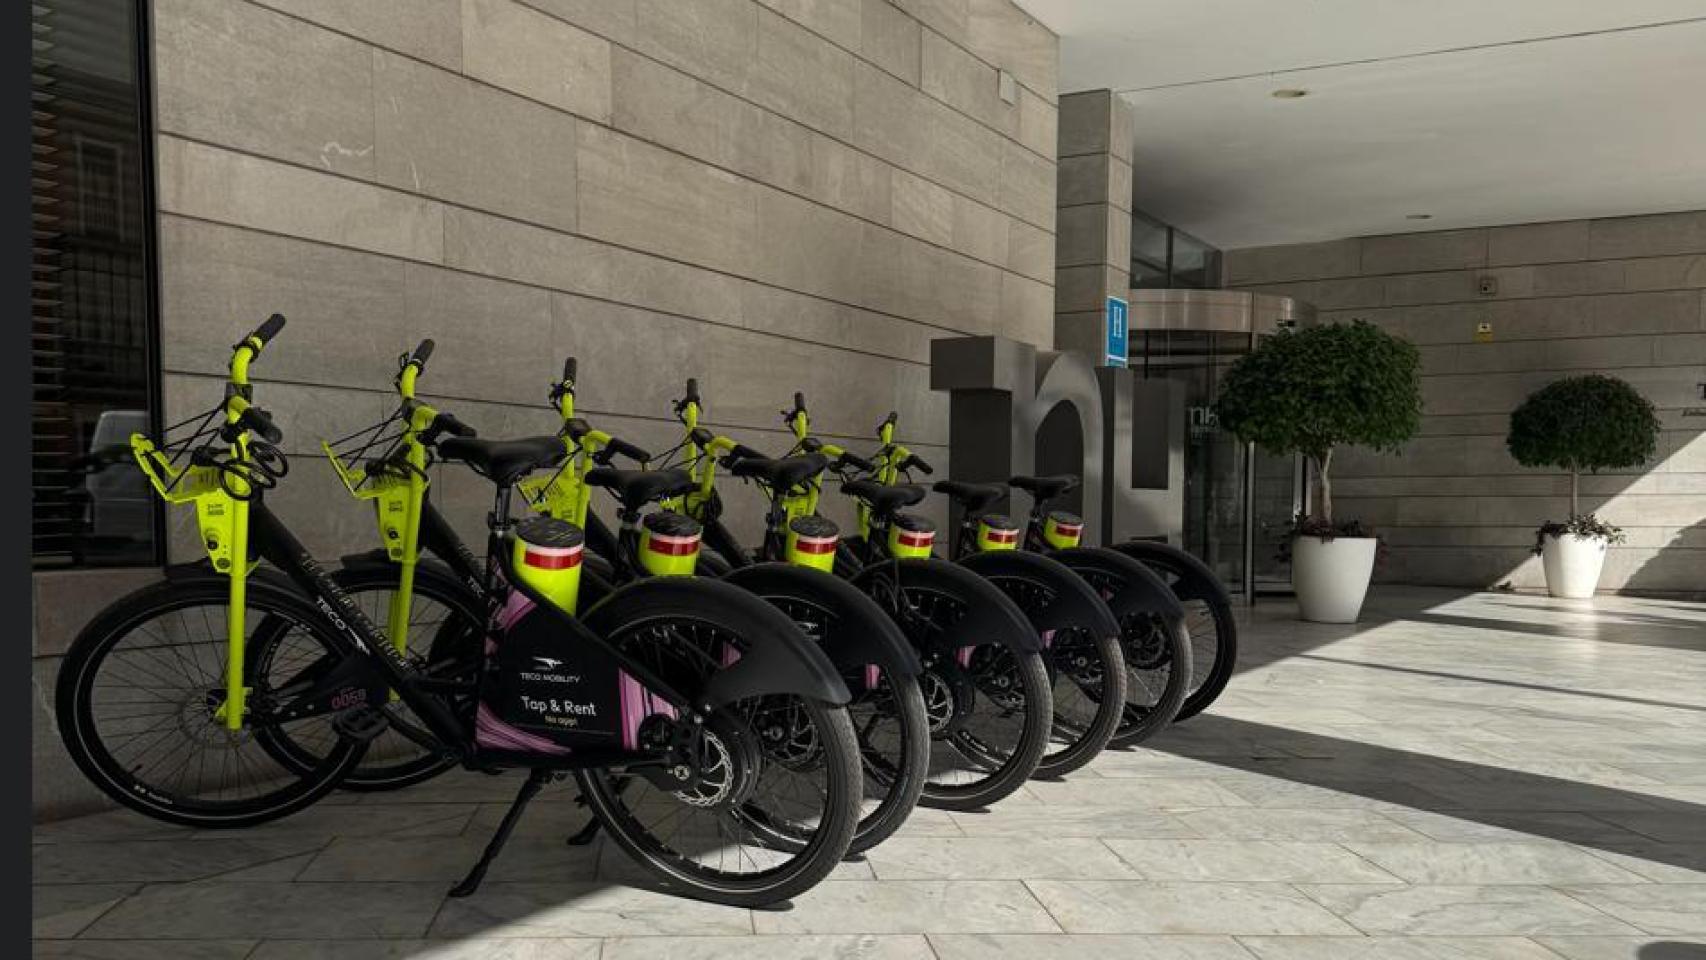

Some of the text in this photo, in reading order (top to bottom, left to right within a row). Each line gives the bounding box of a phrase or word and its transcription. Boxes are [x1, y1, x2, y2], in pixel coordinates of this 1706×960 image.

[1112, 306, 1123, 339] H
[317, 596, 346, 631] TECO
[520, 672, 581, 684] TECO MOBILITY
[520, 696, 597, 716] Tap & Rent
